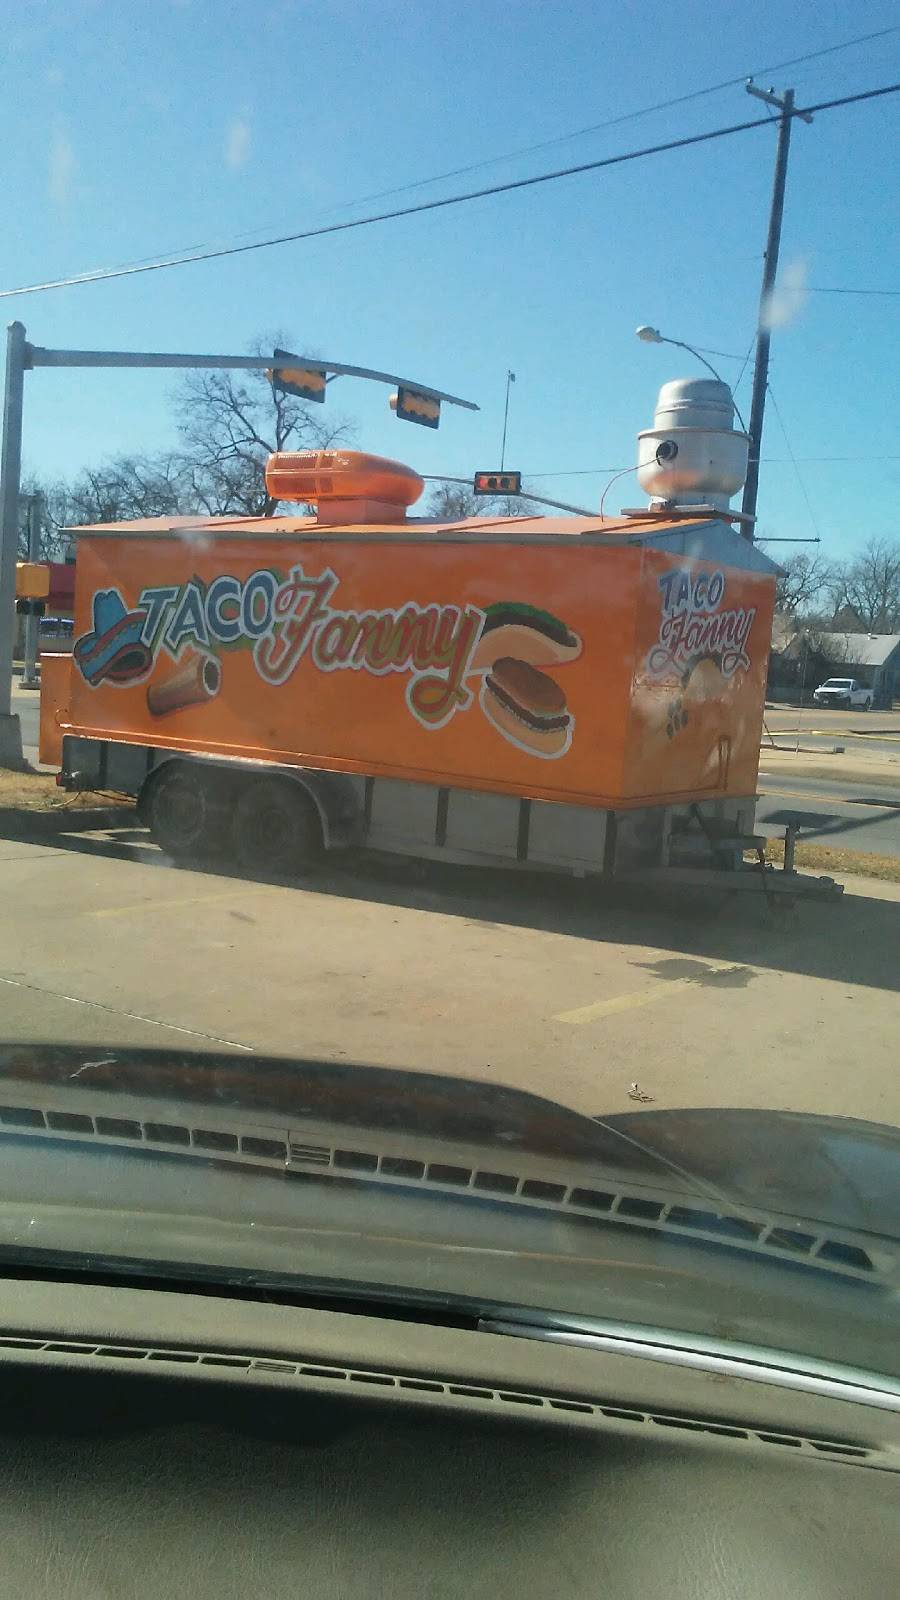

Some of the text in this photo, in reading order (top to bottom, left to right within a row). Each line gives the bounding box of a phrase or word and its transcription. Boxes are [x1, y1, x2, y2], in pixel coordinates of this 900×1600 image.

[659, 569, 725, 612] TACO
[139, 565, 487, 729] TACO Fanny
[648, 607, 756, 678] Fanny
